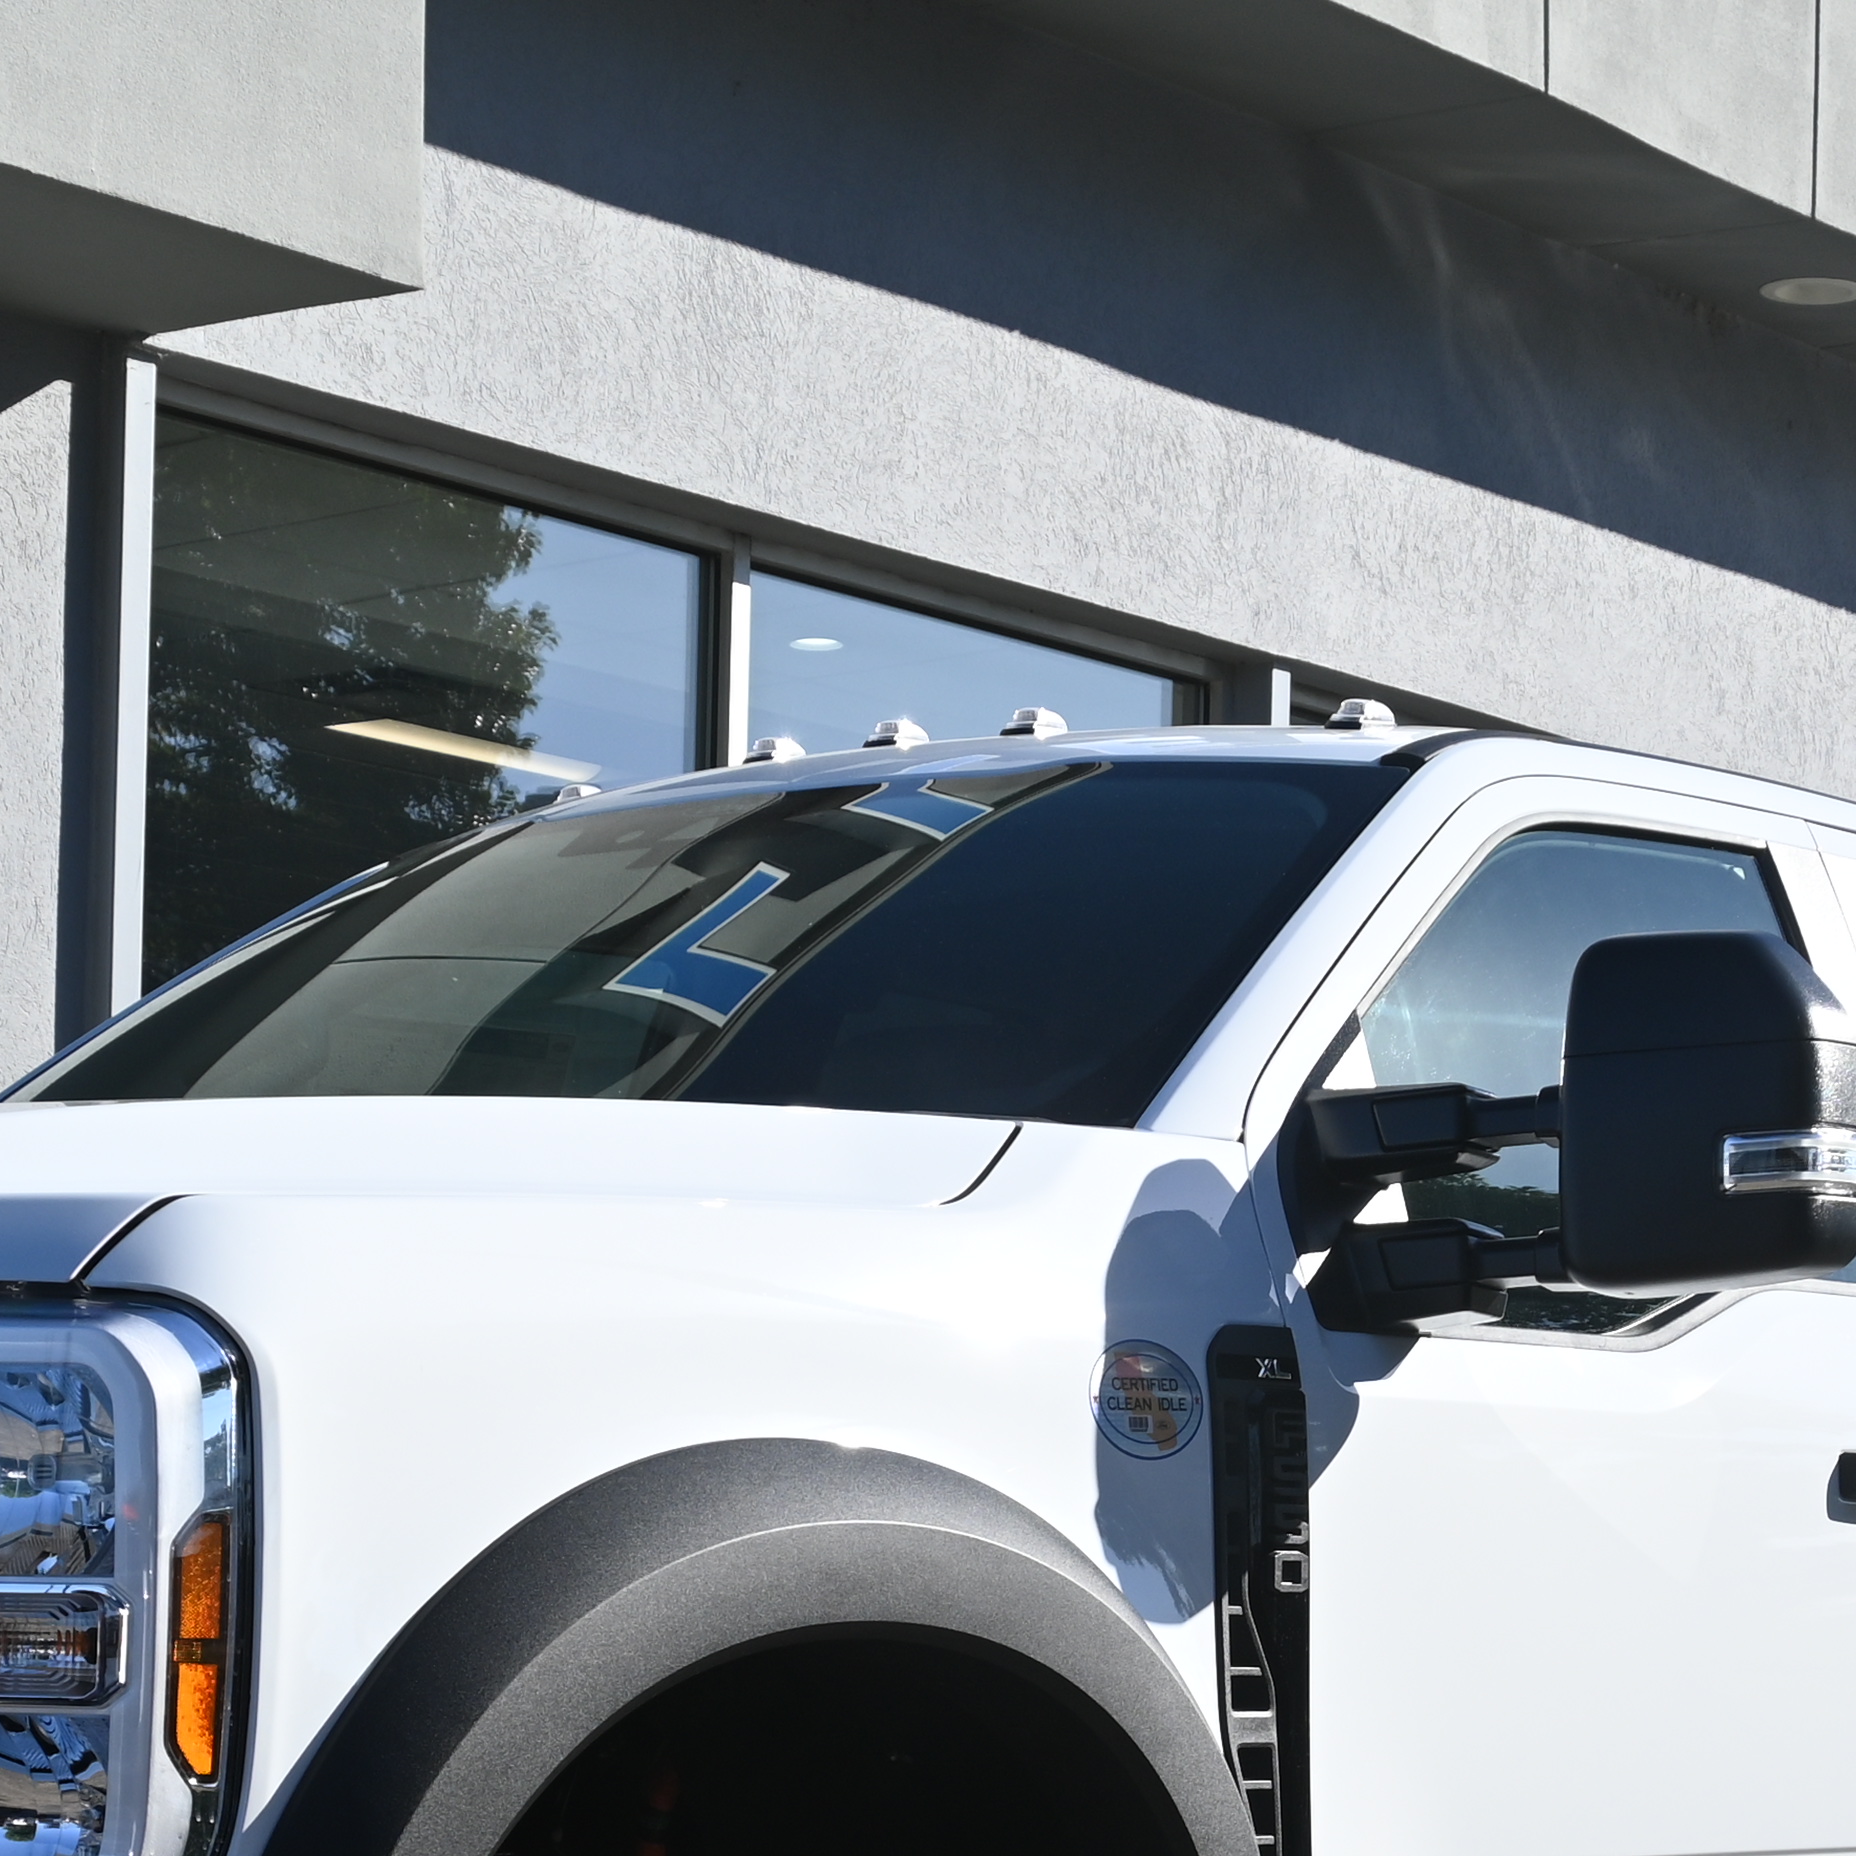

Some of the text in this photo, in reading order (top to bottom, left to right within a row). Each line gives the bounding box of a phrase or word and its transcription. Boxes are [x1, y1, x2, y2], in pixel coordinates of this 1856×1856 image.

[1255, 1357, 1293, 1379] XL
[1111, 1376, 1179, 1392] CERTIFIED
[1106, 1396, 1188, 1412] CLEAN IDLE
